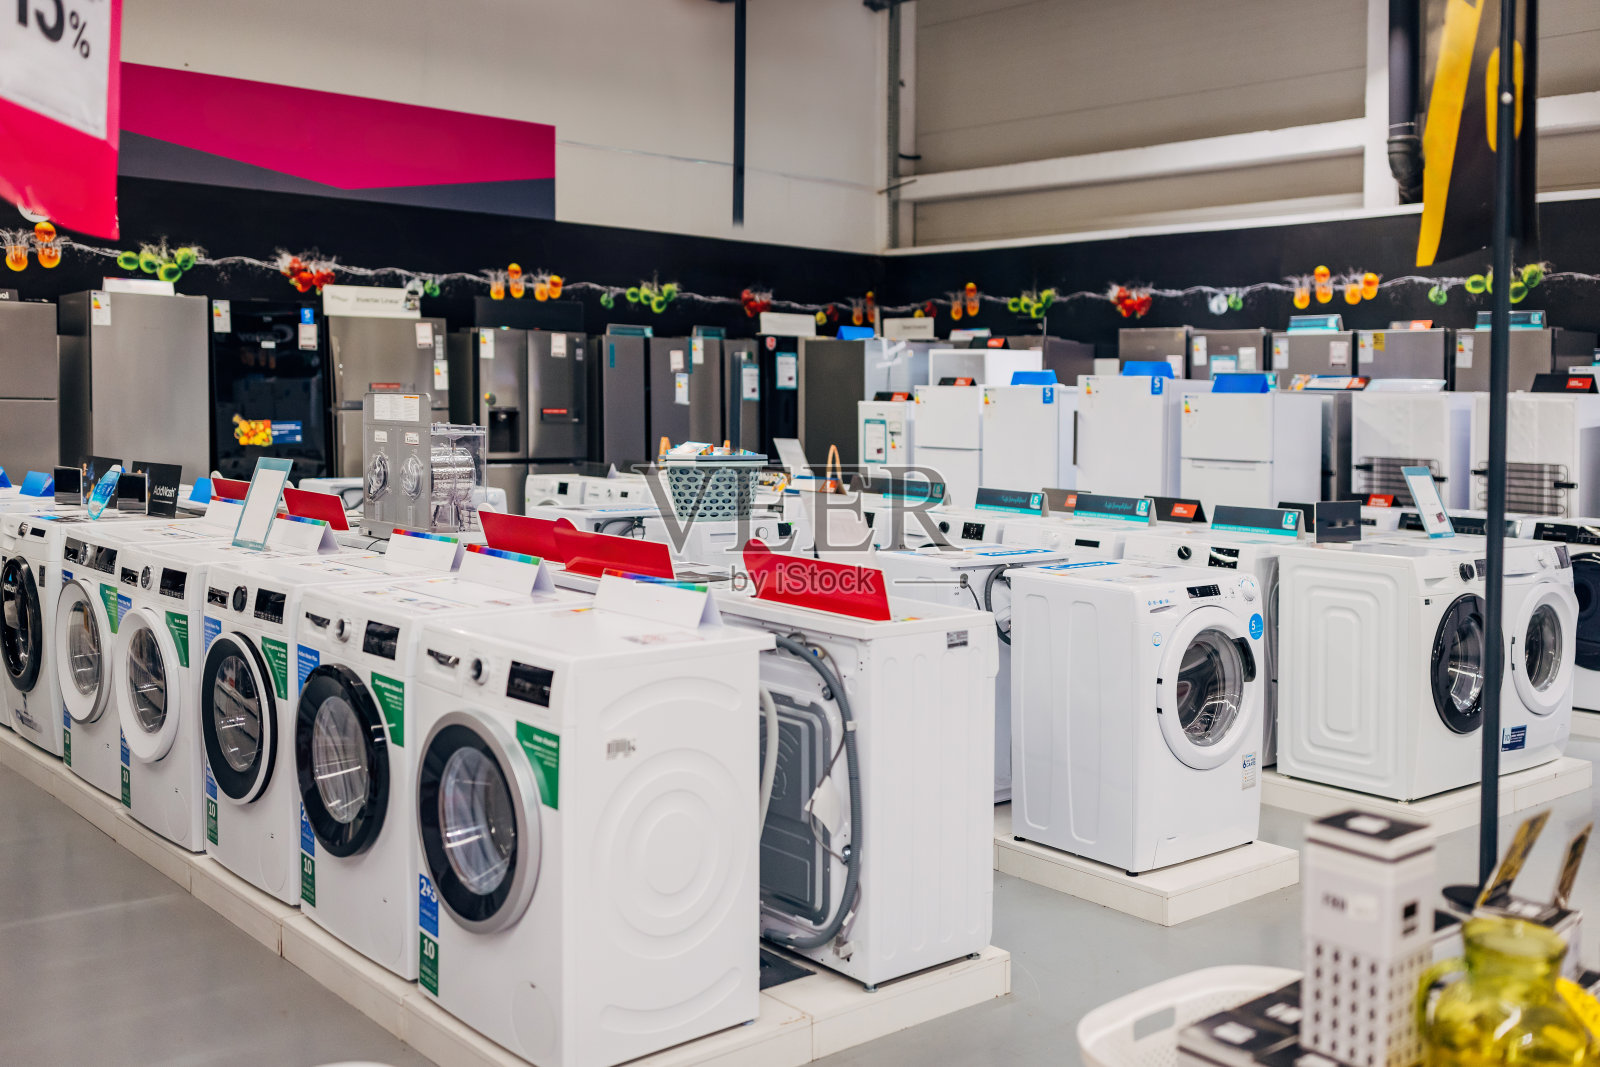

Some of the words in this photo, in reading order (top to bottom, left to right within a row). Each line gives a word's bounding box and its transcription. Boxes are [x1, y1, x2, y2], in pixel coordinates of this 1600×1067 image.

[1286, 514, 1294, 524] 5
[1251, 620, 1256, 630] 5
[208, 801, 216, 818] 10
[303, 856, 313, 875] 10
[423, 937, 436, 960] 10
